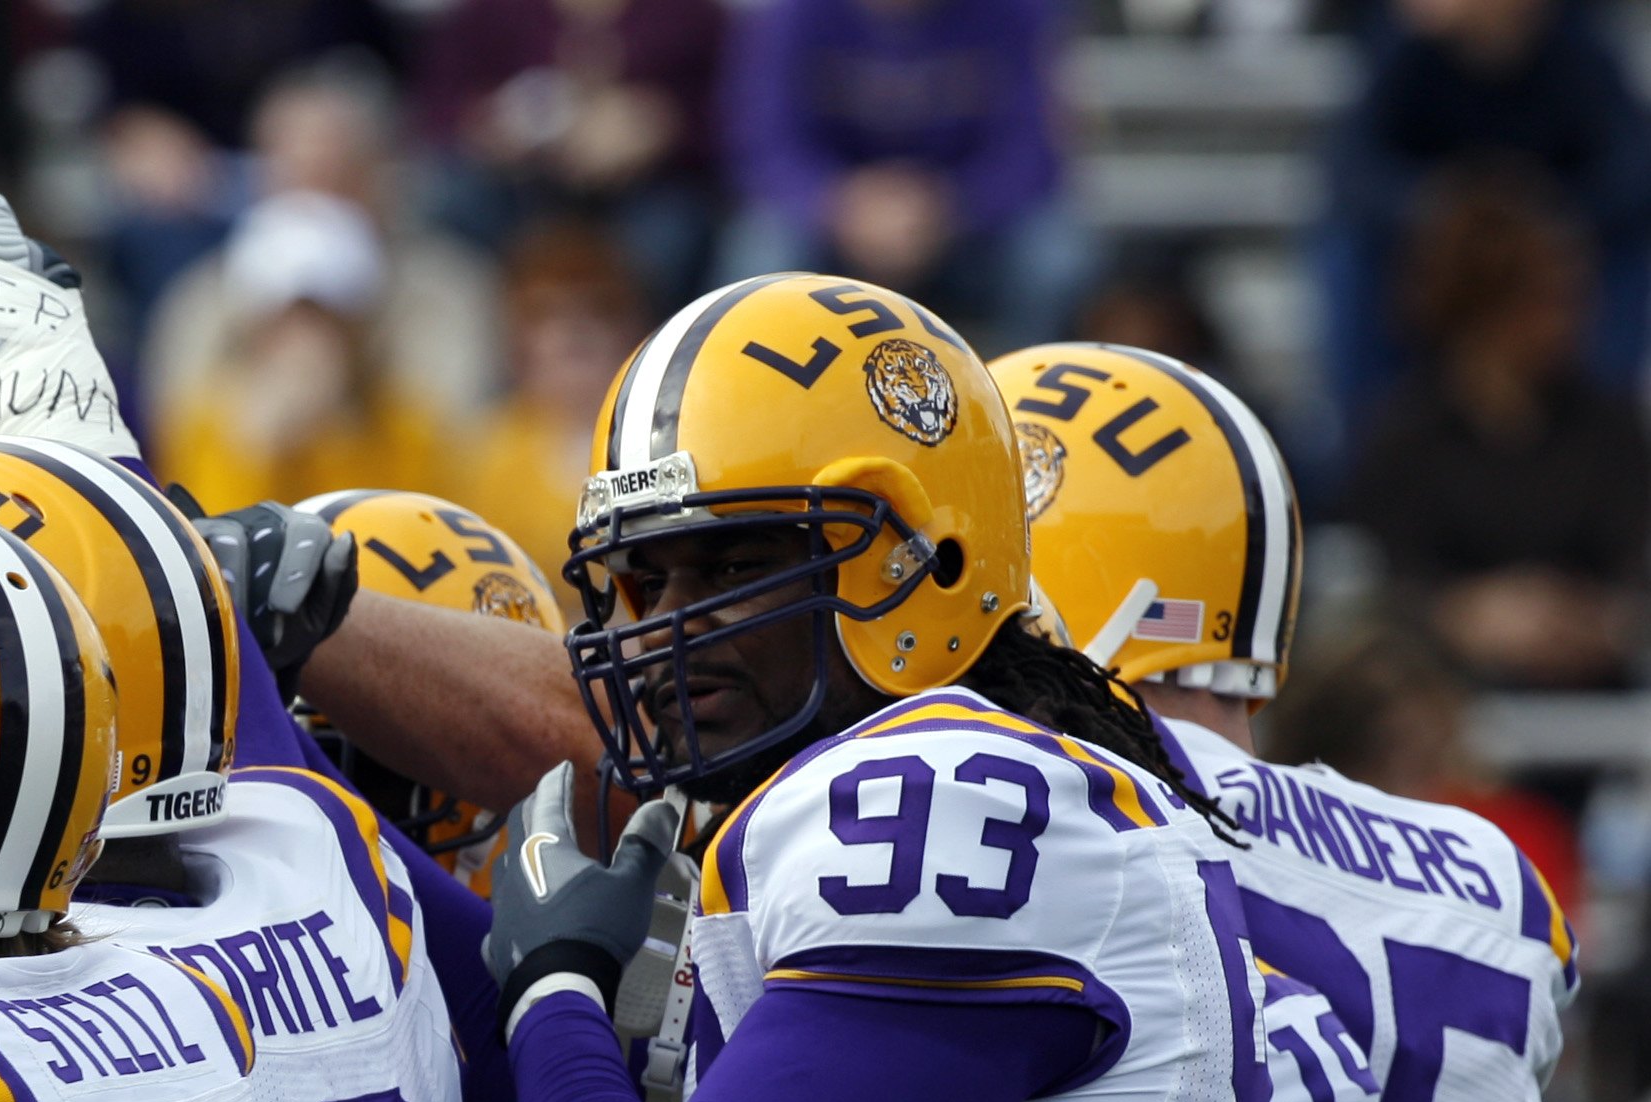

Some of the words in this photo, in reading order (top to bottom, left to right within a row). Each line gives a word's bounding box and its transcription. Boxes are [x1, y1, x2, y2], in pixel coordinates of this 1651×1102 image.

[1015, 363, 1192, 478] SU
[610, 468, 658, 499] TIGERS
[364, 509, 550, 593] LS
[1212, 610, 1232, 642] 3
[131, 753, 152, 786] 9
[146, 782, 226, 822] TIGERS
[819, 751, 1050, 920] 93
[1215, 764, 1502, 912] SANDERS
[49, 859, 68, 890] 6
[146, 910, 383, 1037] ORITE
